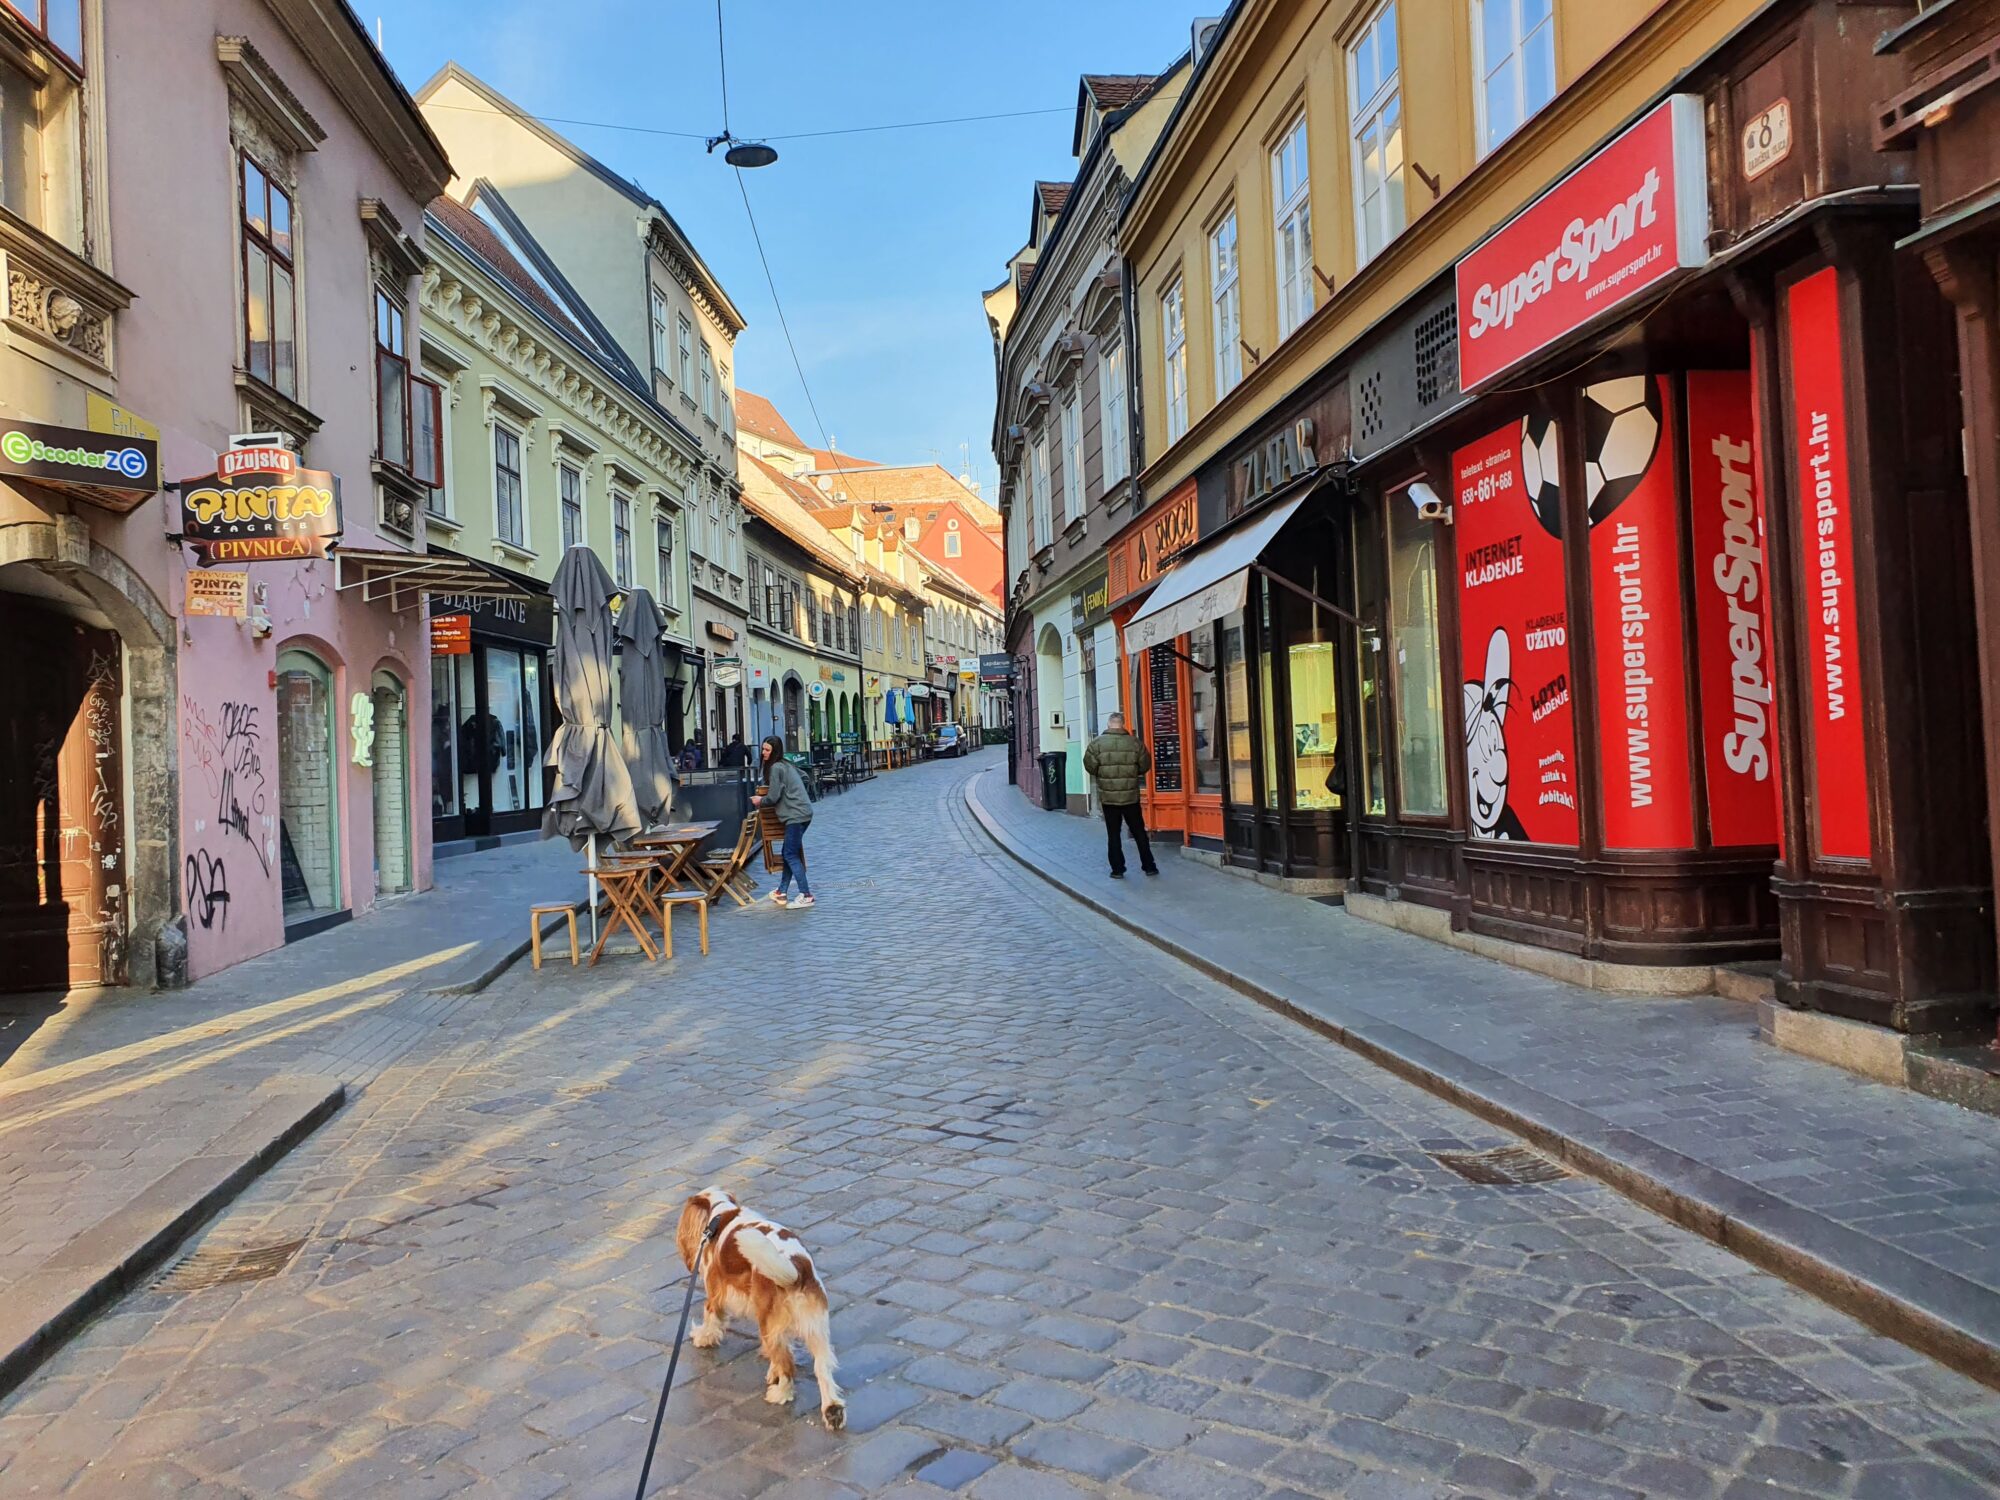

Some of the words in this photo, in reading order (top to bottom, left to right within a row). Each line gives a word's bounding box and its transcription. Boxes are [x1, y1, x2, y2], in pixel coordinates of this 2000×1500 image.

[1759, 113, 1772, 149] 8
[1469, 167, 1660, 339] SuperSport
[1585, 244, 1663, 301] www.supersport.hr
[224, 450, 290, 474] Ožujsko
[1461, 460, 1483, 480] teletext
[1485, 449, 1512, 469] stranica
[186, 485, 333, 525] PINTA
[213, 522, 309, 534] ZAGREB
[1465, 534, 1522, 571] INTERNET
[1809, 411, 1845, 721] www.supersport.hr
[190, 578, 244, 590] PINTA
[1712, 434, 1772, 782] SuperSport
[1525, 627, 1566, 651] UŽIVO
[1612, 522, 1654, 809] www.supersport.hr
[1530, 673, 1567, 711] LOTO
[1538, 789, 1575, 811] dobitak!
